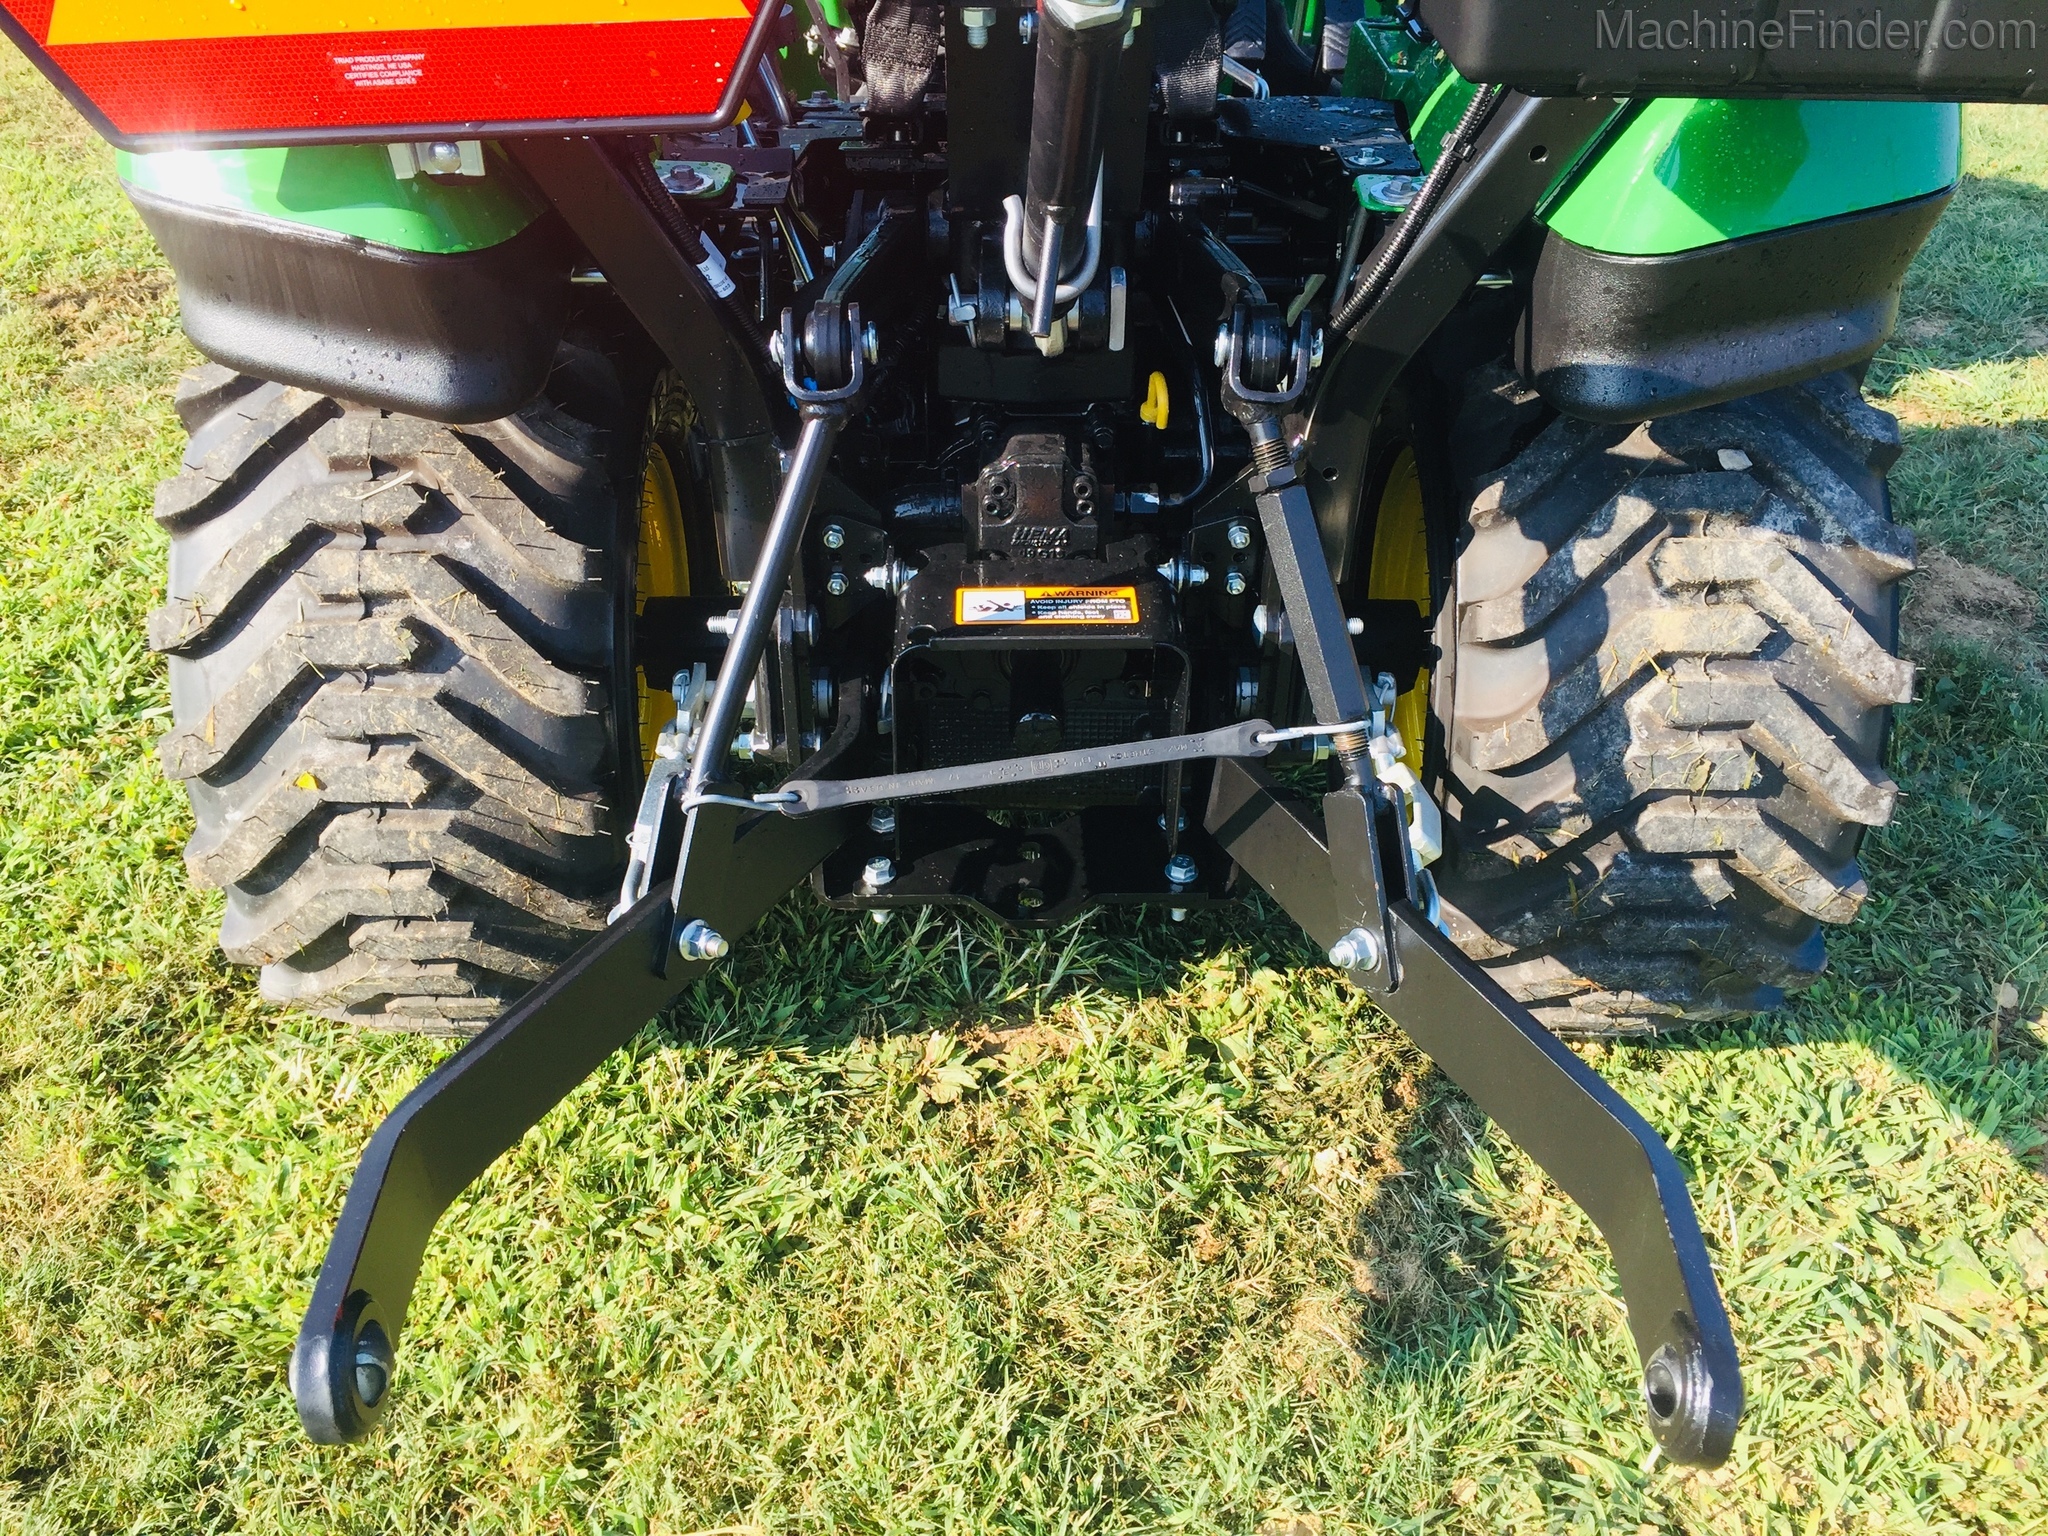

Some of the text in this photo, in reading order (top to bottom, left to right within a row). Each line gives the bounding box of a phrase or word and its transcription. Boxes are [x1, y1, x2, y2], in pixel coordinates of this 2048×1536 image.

[333, 53, 425, 65] TRIAD PRODUCTS COMPANY
[344, 69, 423, 79] CERTIFIES COMPLIANCE
